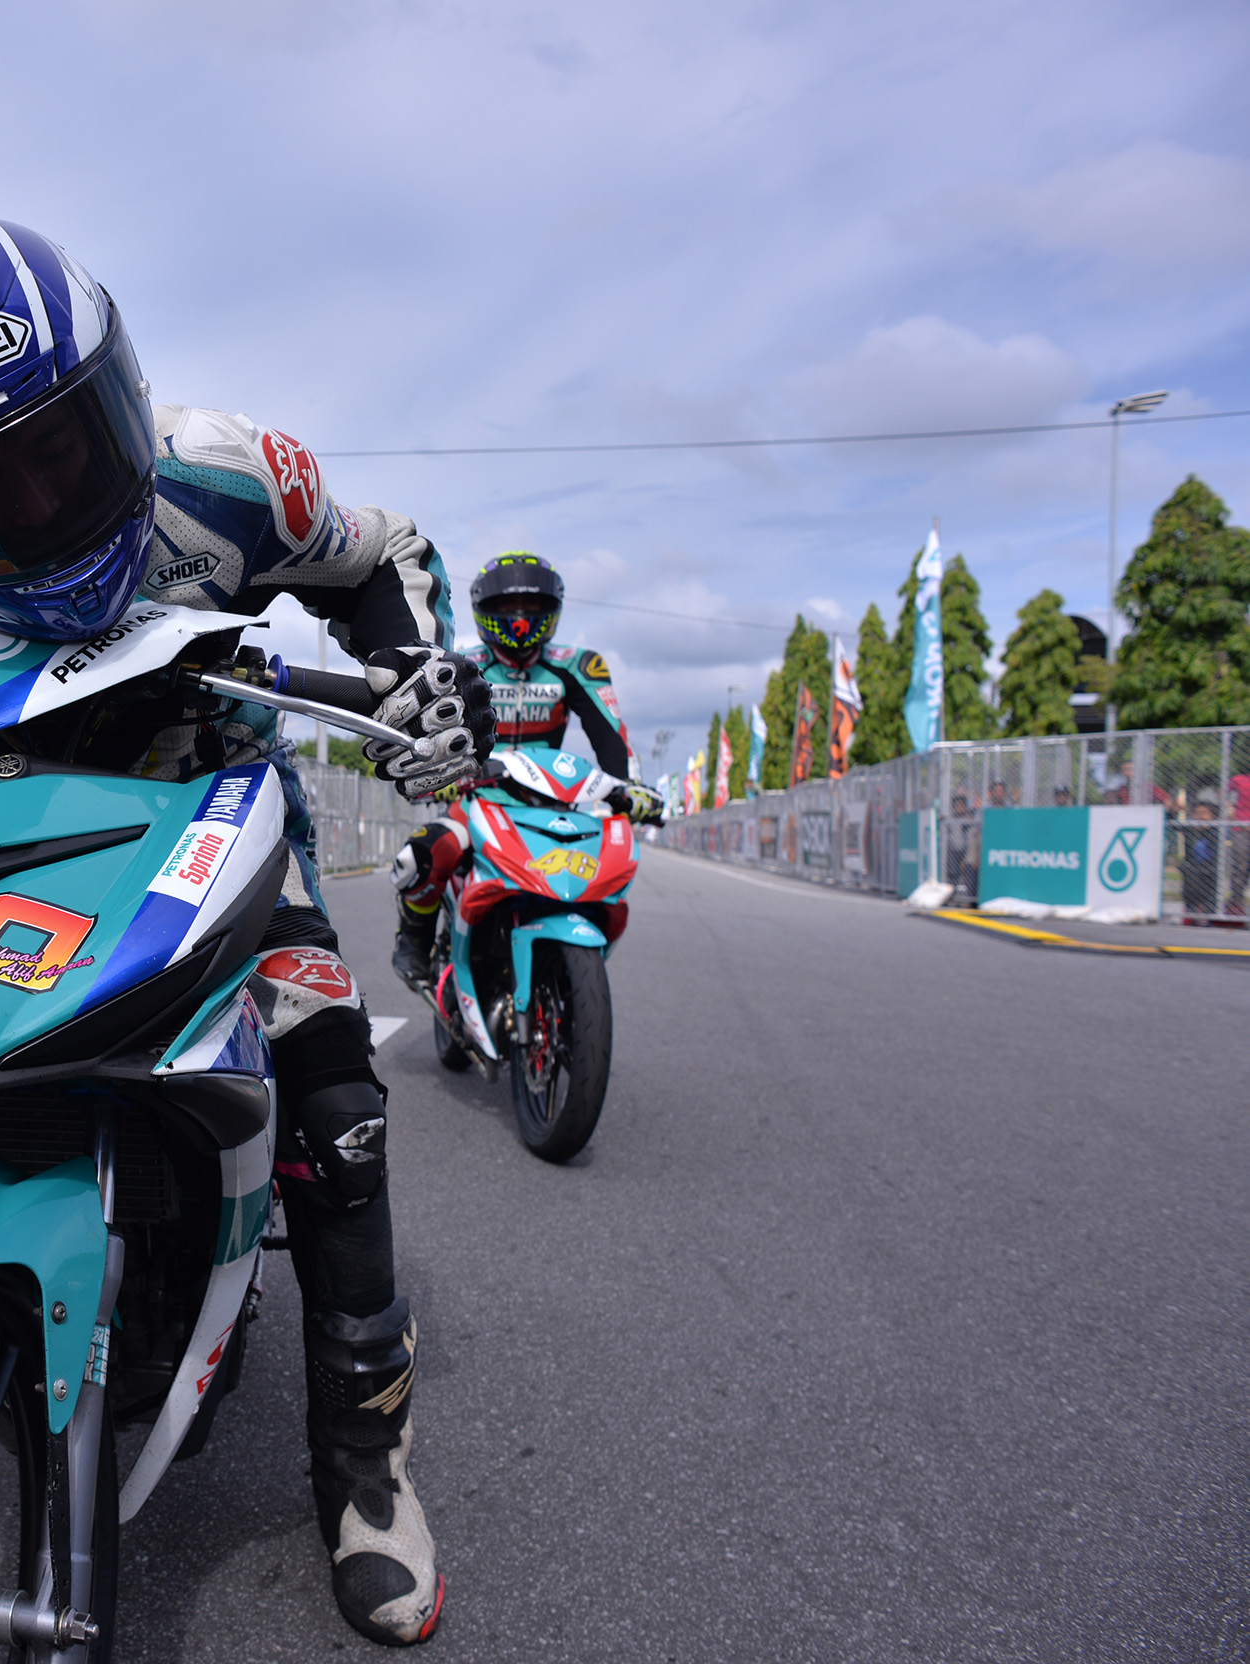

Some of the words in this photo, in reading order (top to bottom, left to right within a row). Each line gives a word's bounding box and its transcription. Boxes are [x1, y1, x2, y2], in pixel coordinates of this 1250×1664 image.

[157, 555, 214, 586] SHOEI
[50, 609, 168, 685] PETRONAS
[202, 777, 253, 821] YAMAHA
[161, 832, 197, 877] PETRONAS
[178, 833, 225, 886] Sprinta
[525, 847, 601, 882] 46
[987, 849, 1080, 870] PETRONAS
